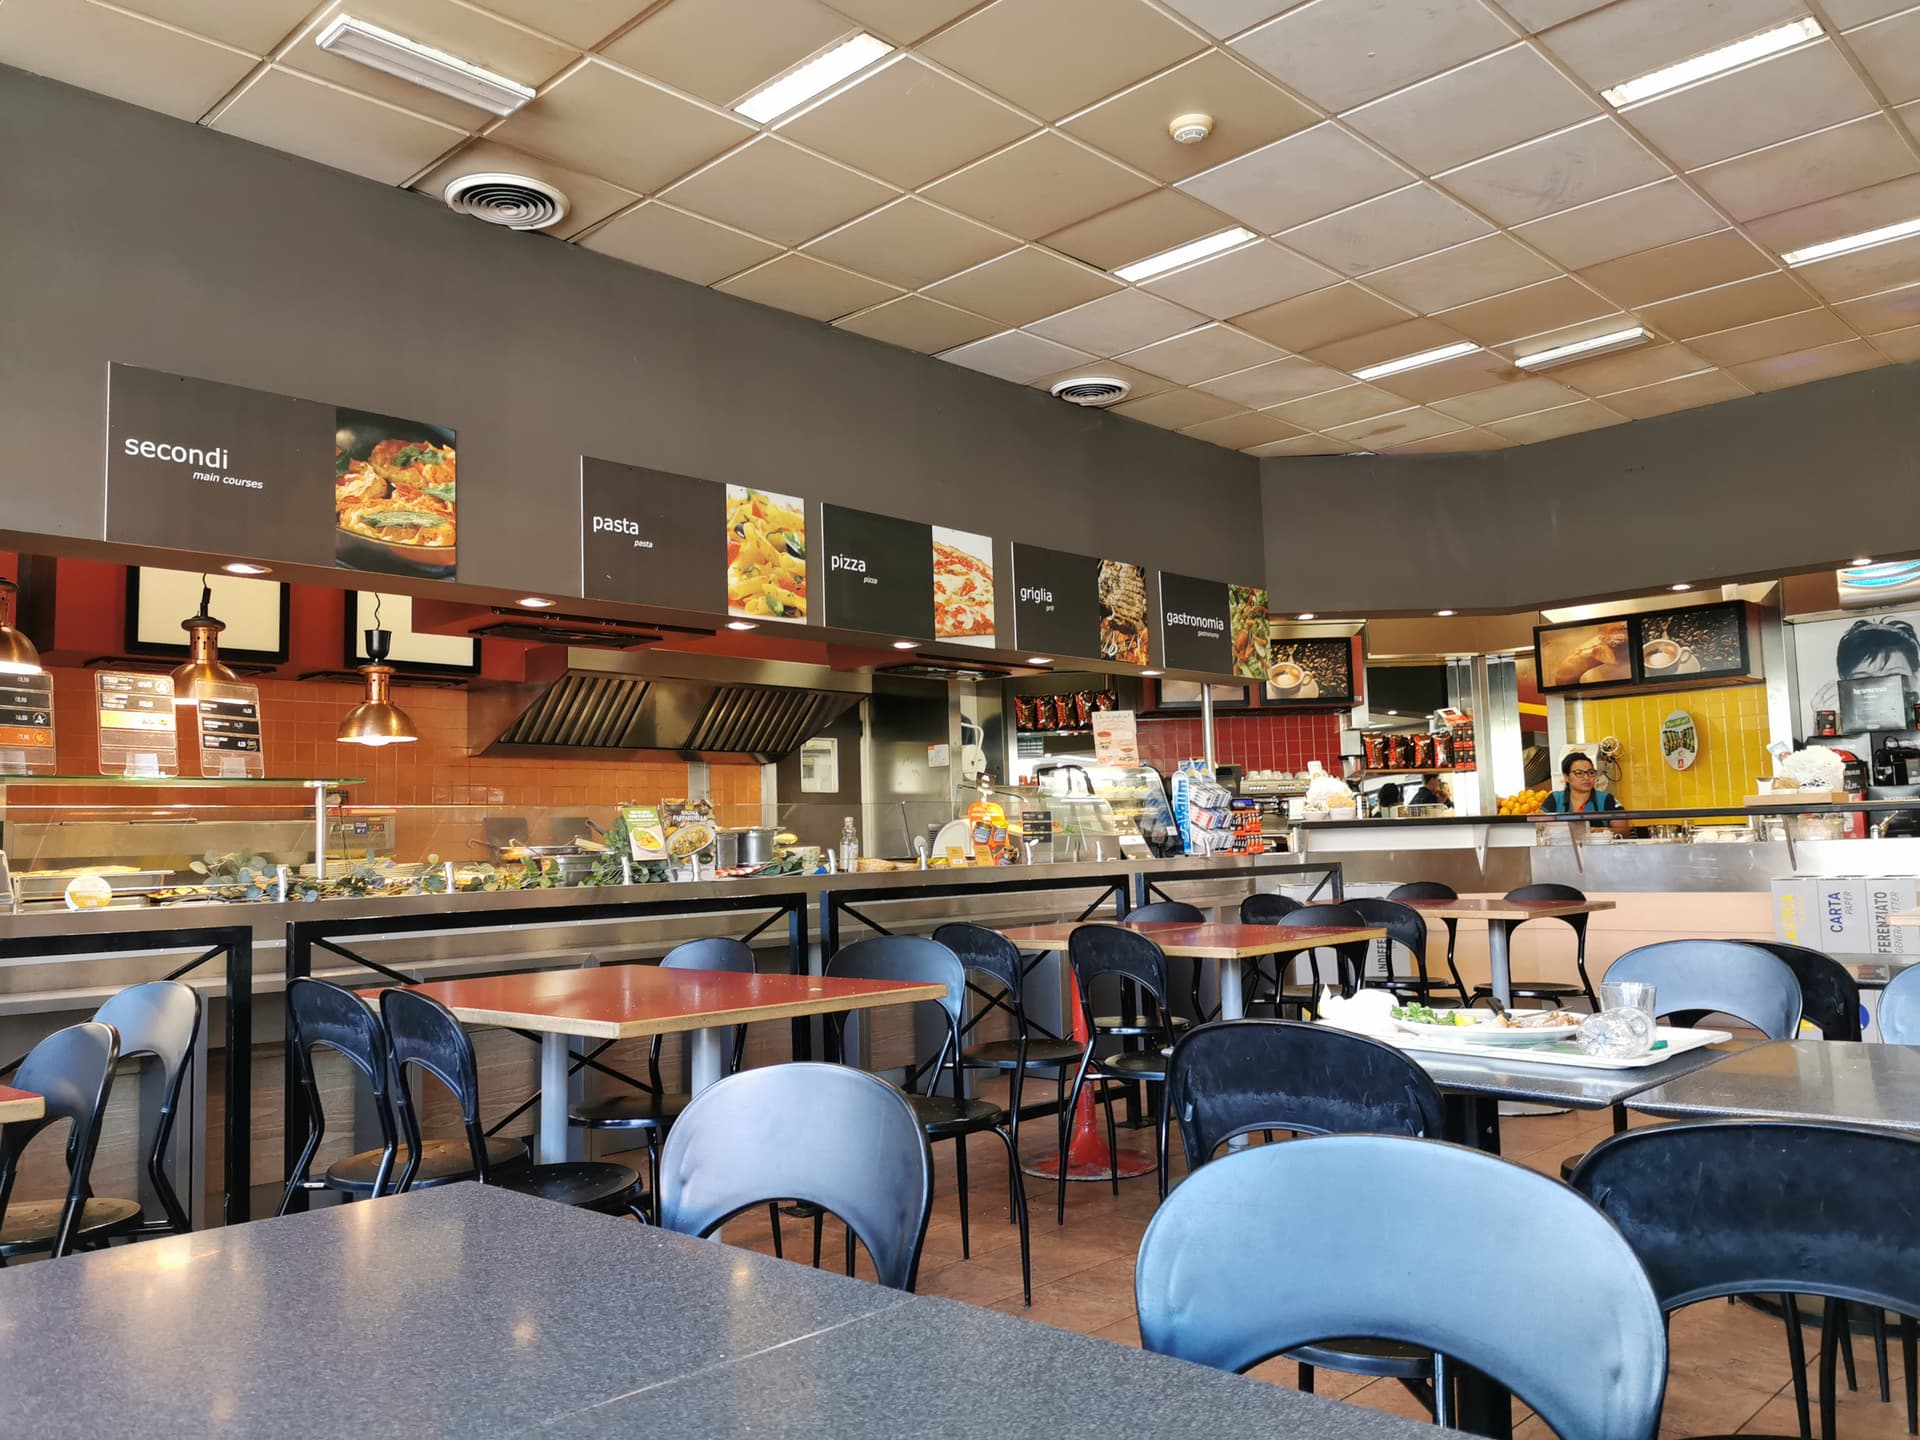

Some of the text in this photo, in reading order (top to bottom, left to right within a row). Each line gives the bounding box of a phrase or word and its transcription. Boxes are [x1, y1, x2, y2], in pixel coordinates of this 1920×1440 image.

[124, 438, 228, 470] secondi
[192, 471, 264, 489] main courses
[593, 516, 639, 535] pasta
[634, 540, 653, 548] pasta
[831, 553, 866, 573] pizza
[1020, 586, 1053, 604] griglia
[1166, 611, 1225, 631] gastronomia
[1828, 891, 1844, 933] CARTA
[1843, 890, 1853, 915] PAPER
[1781, 893, 1799, 946] ASTICA
[1873, 891, 1892, 954] FERENZIATO
